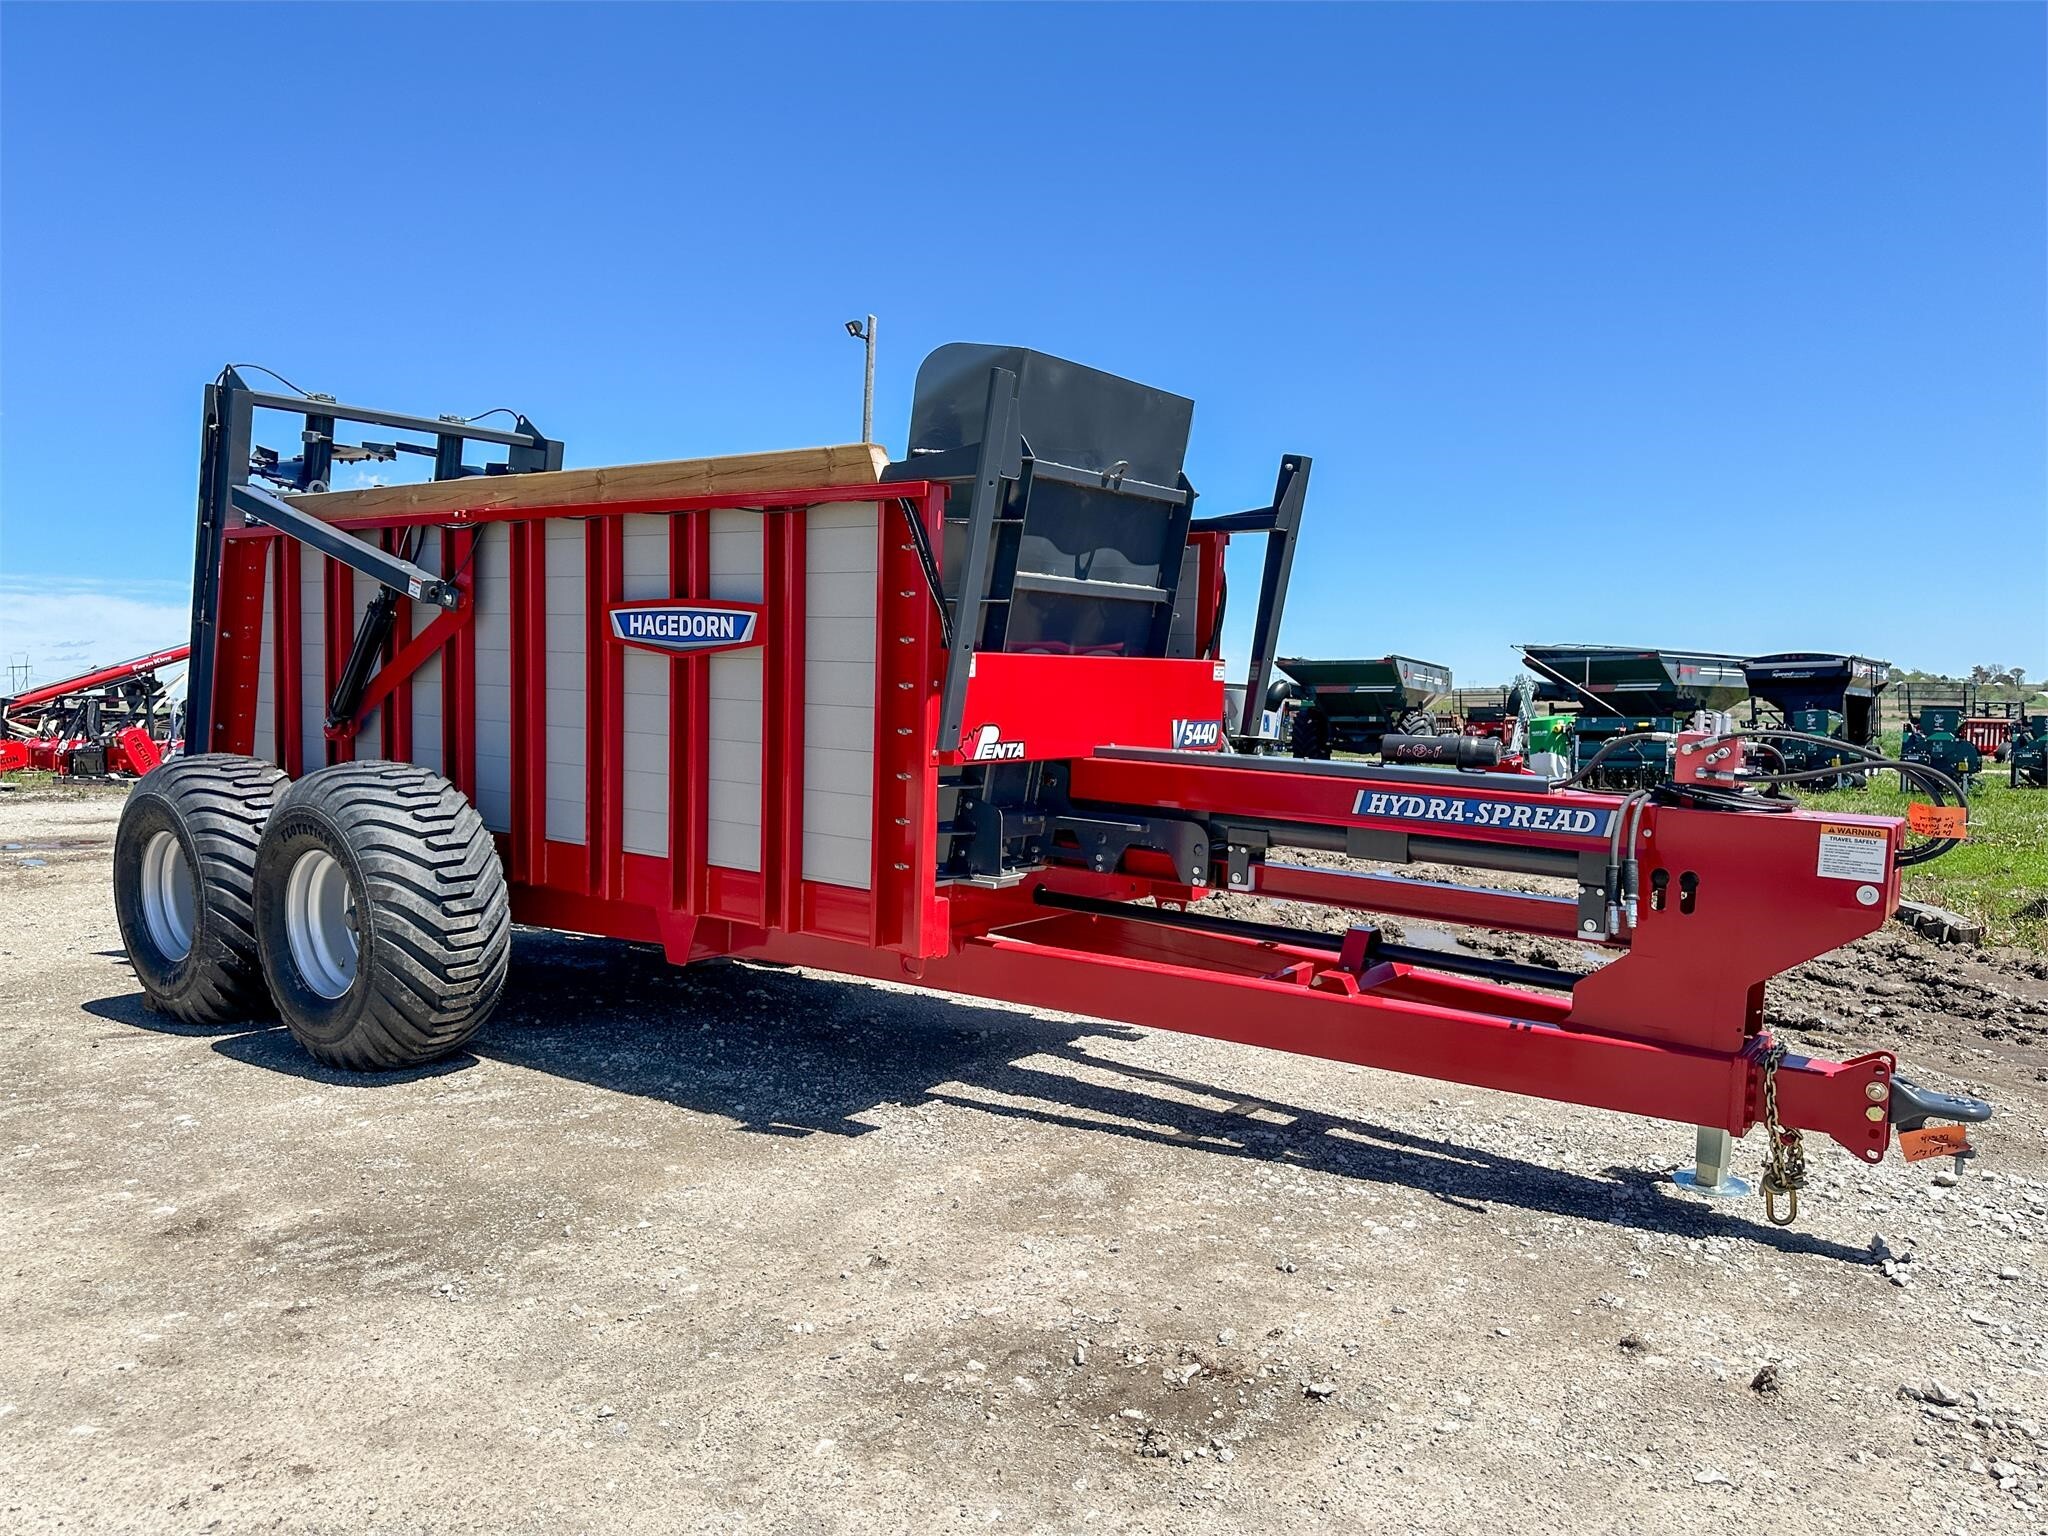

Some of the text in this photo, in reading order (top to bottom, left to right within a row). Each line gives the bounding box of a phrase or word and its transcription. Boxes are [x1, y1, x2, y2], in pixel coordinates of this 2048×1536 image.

[629, 614, 734, 638] HAGEDORN
[973, 725, 1025, 760] PENTA
[1172, 719, 1218, 749] V5440
[130, 736, 153, 767] FECON
[1367, 793, 1596, 833] HYDRA-SPREAD
[280, 822, 331, 846] FLOTATION
[1836, 827, 1881, 838] WARNING
